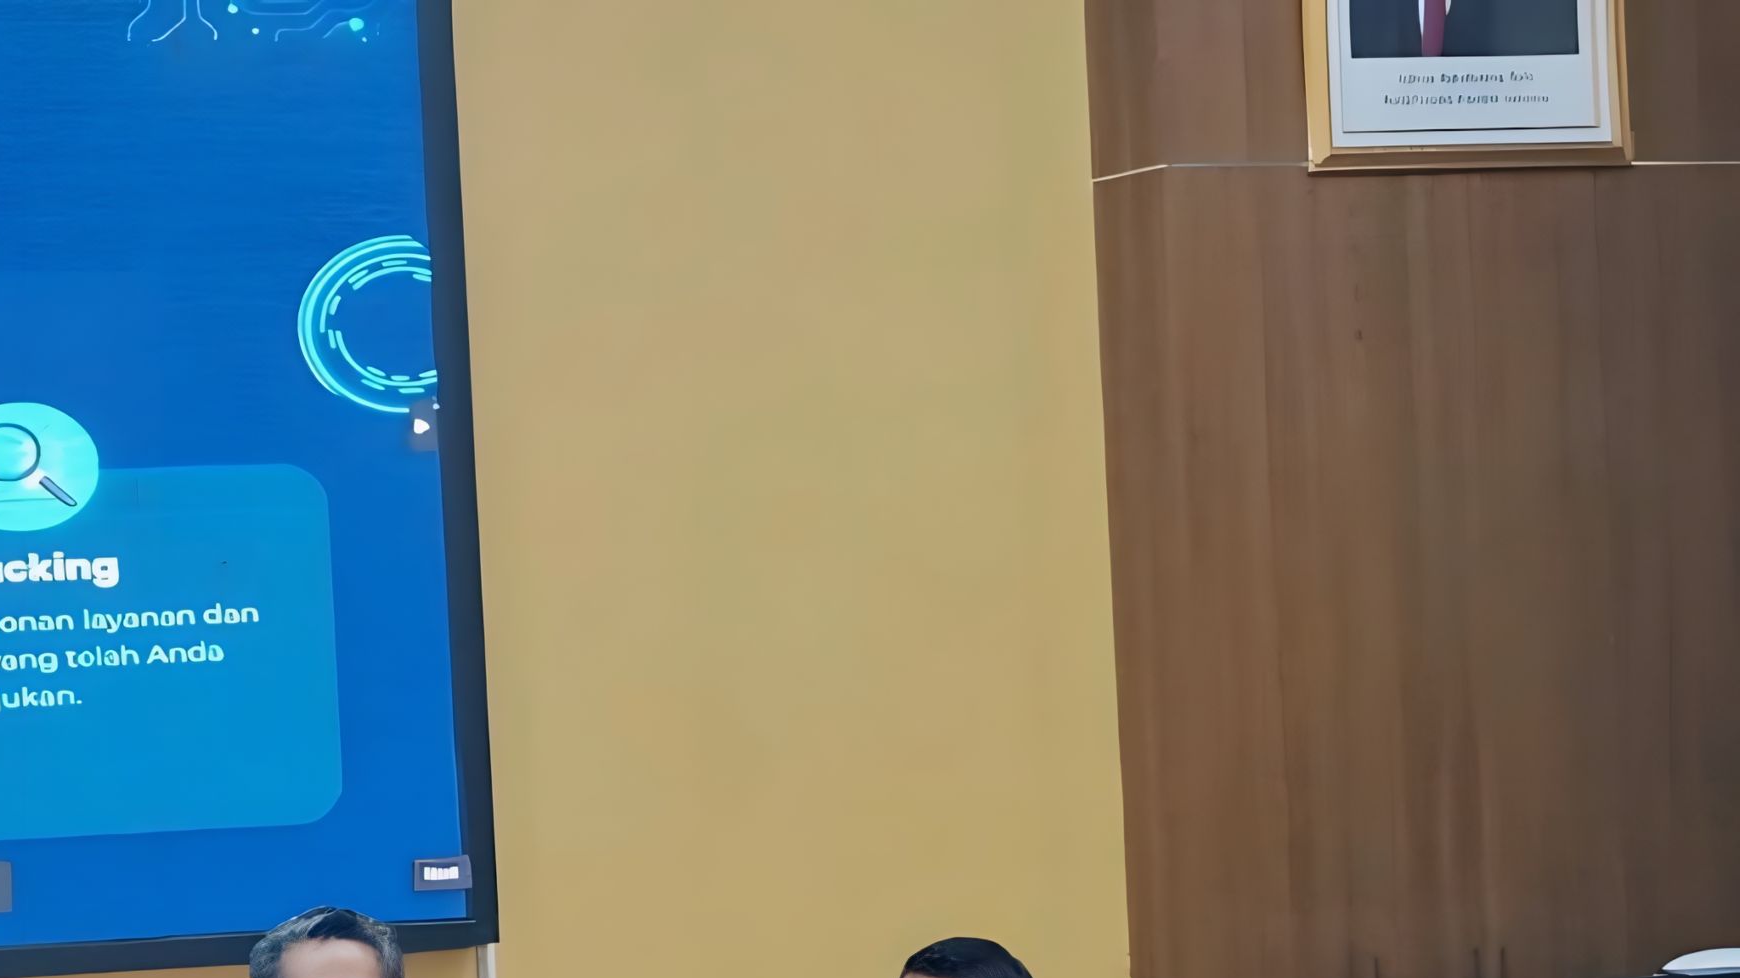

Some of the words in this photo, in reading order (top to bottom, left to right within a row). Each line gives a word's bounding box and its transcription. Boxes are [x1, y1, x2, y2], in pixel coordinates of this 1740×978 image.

[83, 608, 196, 634] layanan
[202, 602, 260, 625] dan
[146, 640, 225, 665] Anda
